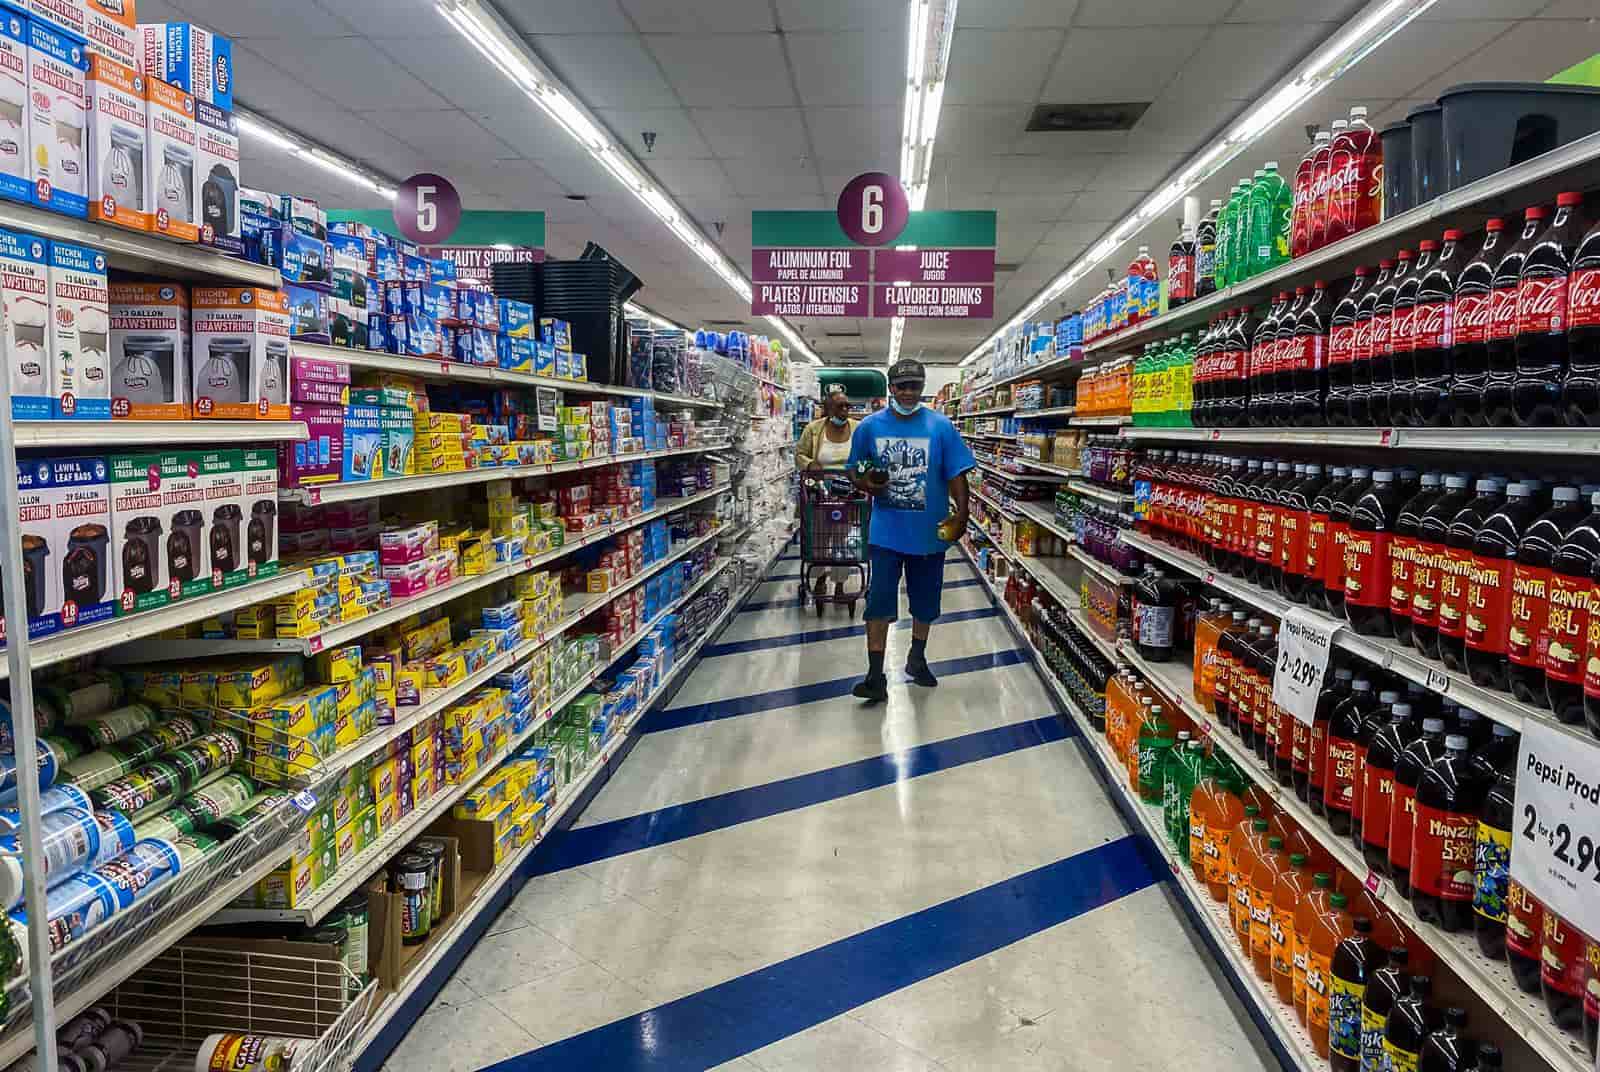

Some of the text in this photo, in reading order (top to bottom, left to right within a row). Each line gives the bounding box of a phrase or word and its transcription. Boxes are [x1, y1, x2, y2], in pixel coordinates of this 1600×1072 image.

[101, 18, 126, 37] GALLON
[32, 26, 59, 46] KITCHEN
[88, 22, 135, 57] DRAWSTRING
[144, 28, 155, 75] DRAWST
[51, 61, 74, 80] GALLON
[33, 65, 84, 98] DRAWSTRING
[100, 97, 146, 128] DRAWSTRING
[155, 119, 195, 146] DRAWSTRING
[201, 139, 239, 161] DRAWSTRING
[417, 186, 437, 232] 5
[862, 185, 883, 234] 6
[55, 246, 82, 259] KITCHEN
[442, 250, 533, 268] BEAUTY SUPPLIES
[55, 256, 74, 268] TRASH
[769, 252, 851, 269] ALUMINUM FOIL
[919, 251, 950, 270] JUICE
[8, 264, 35, 277] GALLON
[777, 270, 844, 281] PAPEL DE ALUMINIO
[923, 270, 946, 281] JUGOS
[65, 275, 98, 287] 13 GALLON
[56, 283, 107, 304] DRAWSTRING
[195, 290, 228, 300] KITCHEN
[762, 286, 859, 304] PLATES / UTENSILS
[885, 287, 983, 305] FLAVORED DRINKS
[119, 309, 163, 317] 13 GALLON
[775, 304, 801, 315] PLATOS
[897, 305, 928, 316] BEBIDAS
[929, 305, 944, 316] CON
[196, 321, 253, 332] DRAWSTRING
[62, 396, 74, 409] 40
[112, 401, 128, 411] 45
[197, 400, 211, 410] 45
[353, 407, 379, 419] PORTABLE
[344, 418, 366, 429] STORAGE
[54, 463, 74, 474] LAWN
[55, 470, 92, 484] LEAF BAGS
[177, 482, 196, 492] GALLON
[206, 485, 242, 500] DRAWSTRING
[76, 492, 99, 502] GALLON
[117, 496, 162, 511] DRAWSTRING
[164, 489, 204, 505] DRAWSTRING
[20, 506, 51, 520] STRING
[57, 501, 108, 518] DRAWSTRING
[1512, 578, 1546, 599] ZANITA
[122, 596, 135, 607] 20
[1550, 588, 1590, 610] ZANIT
[1280, 651, 1288, 673] 2
[1527, 753, 1563, 786] Pepsi
[1523, 804, 1537, 842] 2
